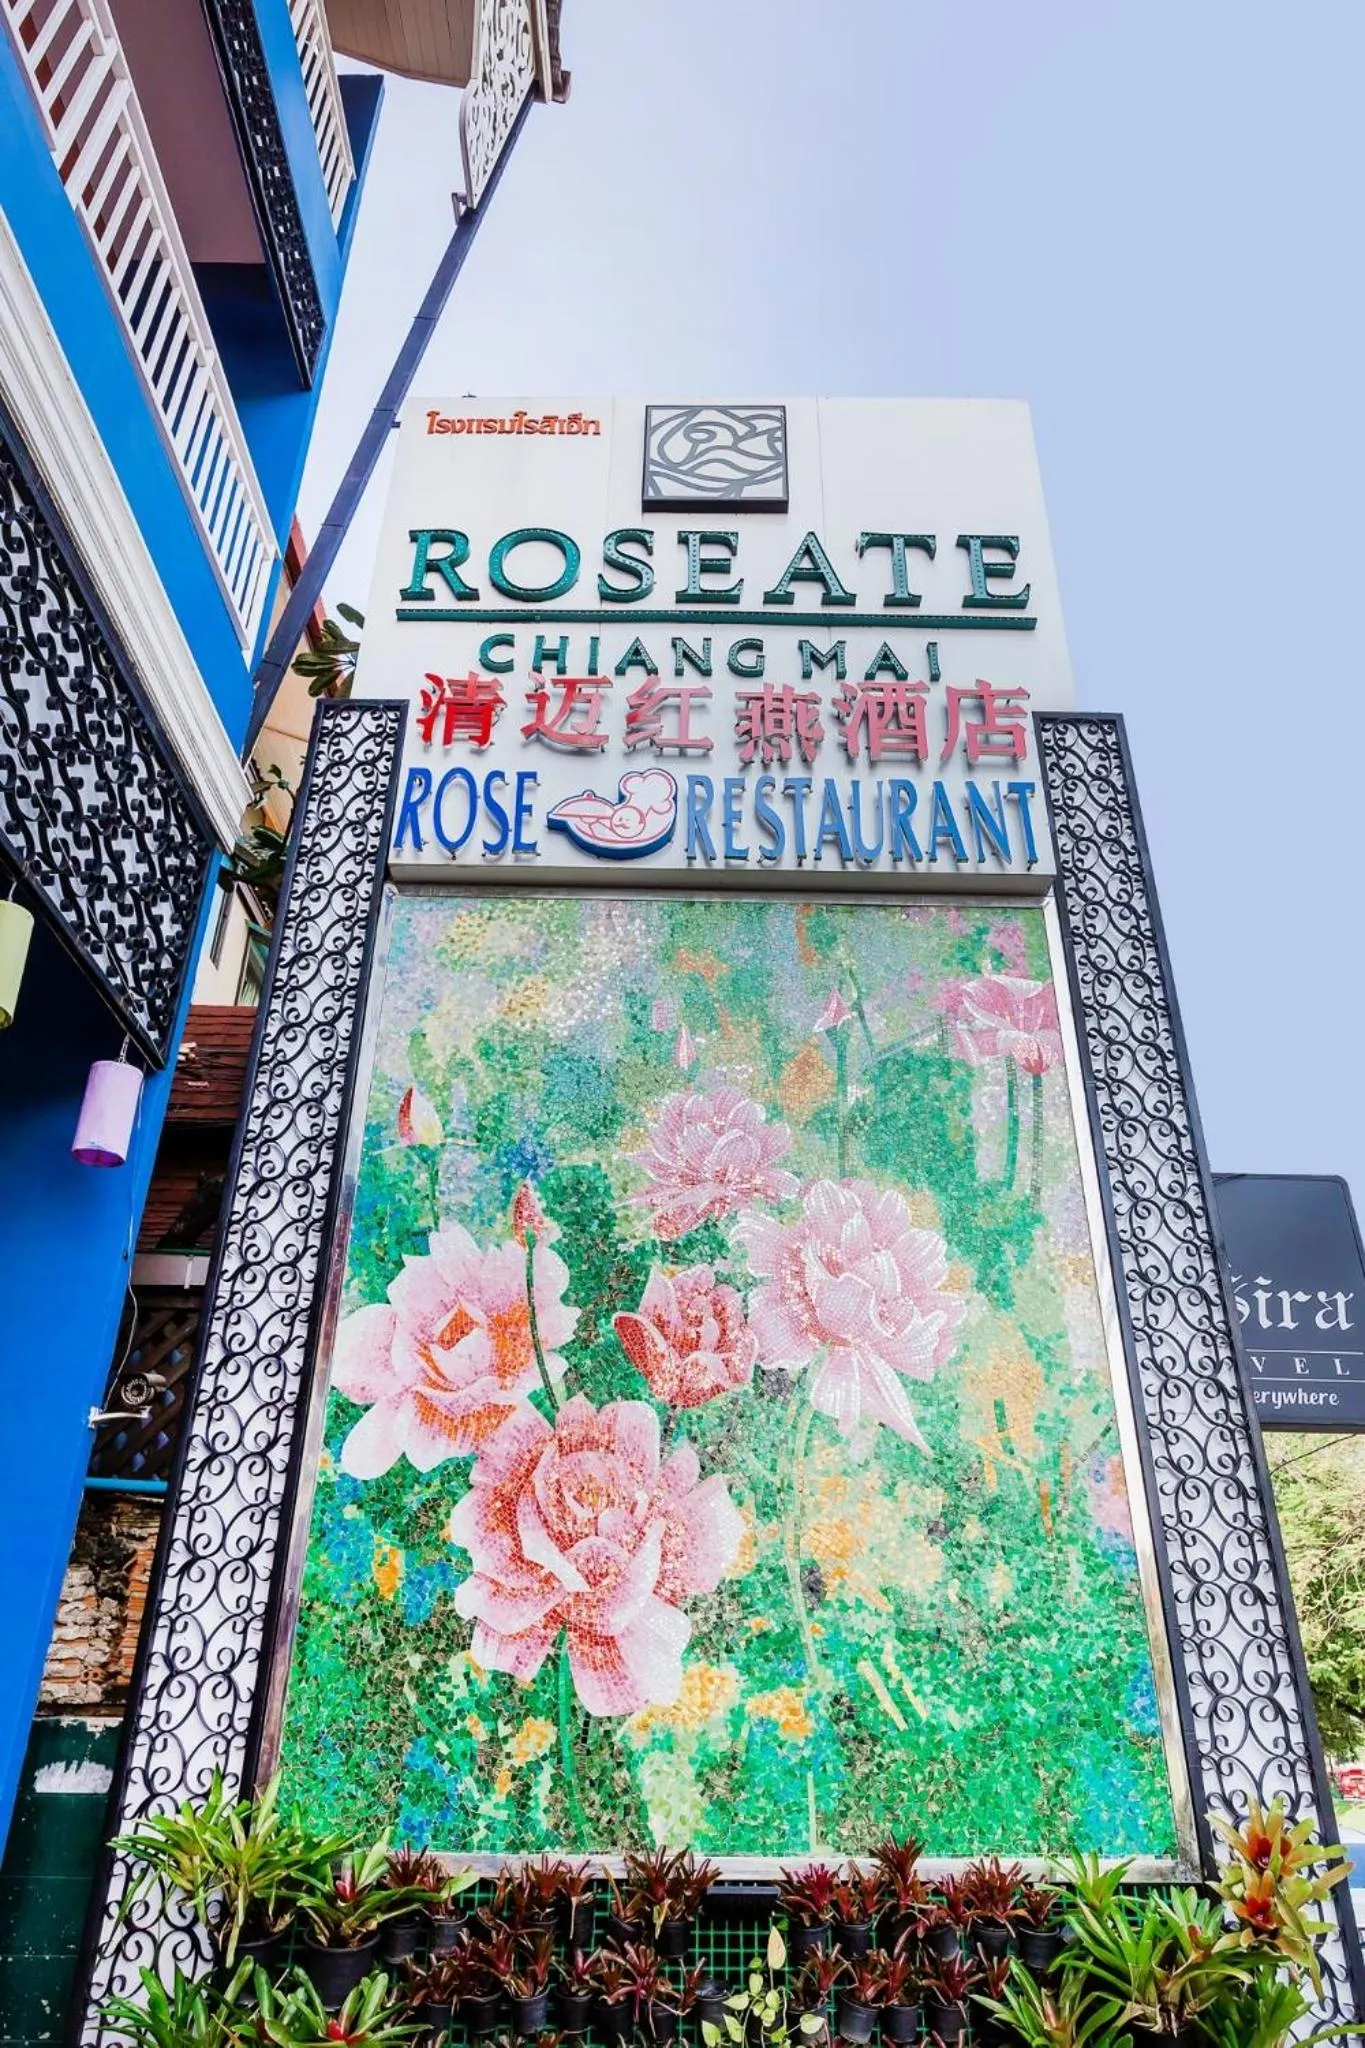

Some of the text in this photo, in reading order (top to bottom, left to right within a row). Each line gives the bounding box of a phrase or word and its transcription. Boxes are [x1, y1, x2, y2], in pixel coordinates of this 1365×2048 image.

[399, 528, 1031, 606] ROSEATE
[479, 634, 940, 681] CHIANG MAI
[416, 671, 1031, 763] 清迈红燕酒店
[393, 767, 1036, 870] ROSE RESTAURANT
